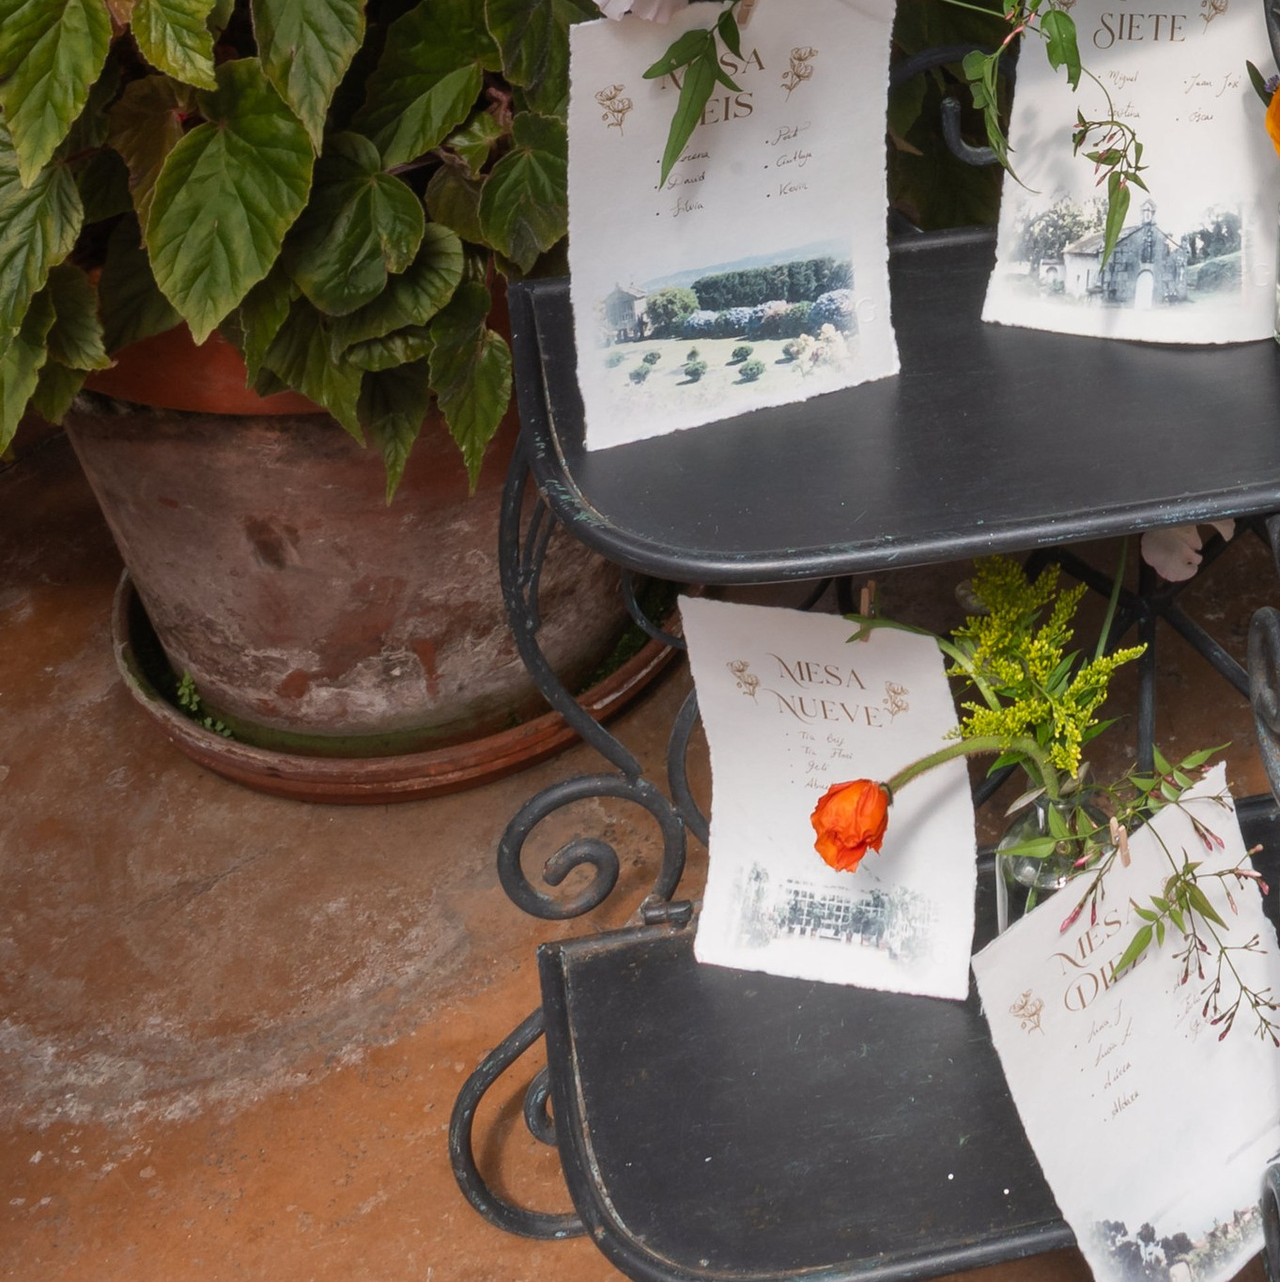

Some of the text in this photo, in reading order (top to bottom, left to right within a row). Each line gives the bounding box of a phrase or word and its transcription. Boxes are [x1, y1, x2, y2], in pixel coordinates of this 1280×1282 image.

[1093, 13, 1187, 50] SIETE
[700, 92, 754, 126] EIS
[678, 146, 710, 163] orena
[766, 652, 867, 691] MESA
[764, 688, 884, 729] NUEVE
[1046, 897, 1140, 976] MESA
